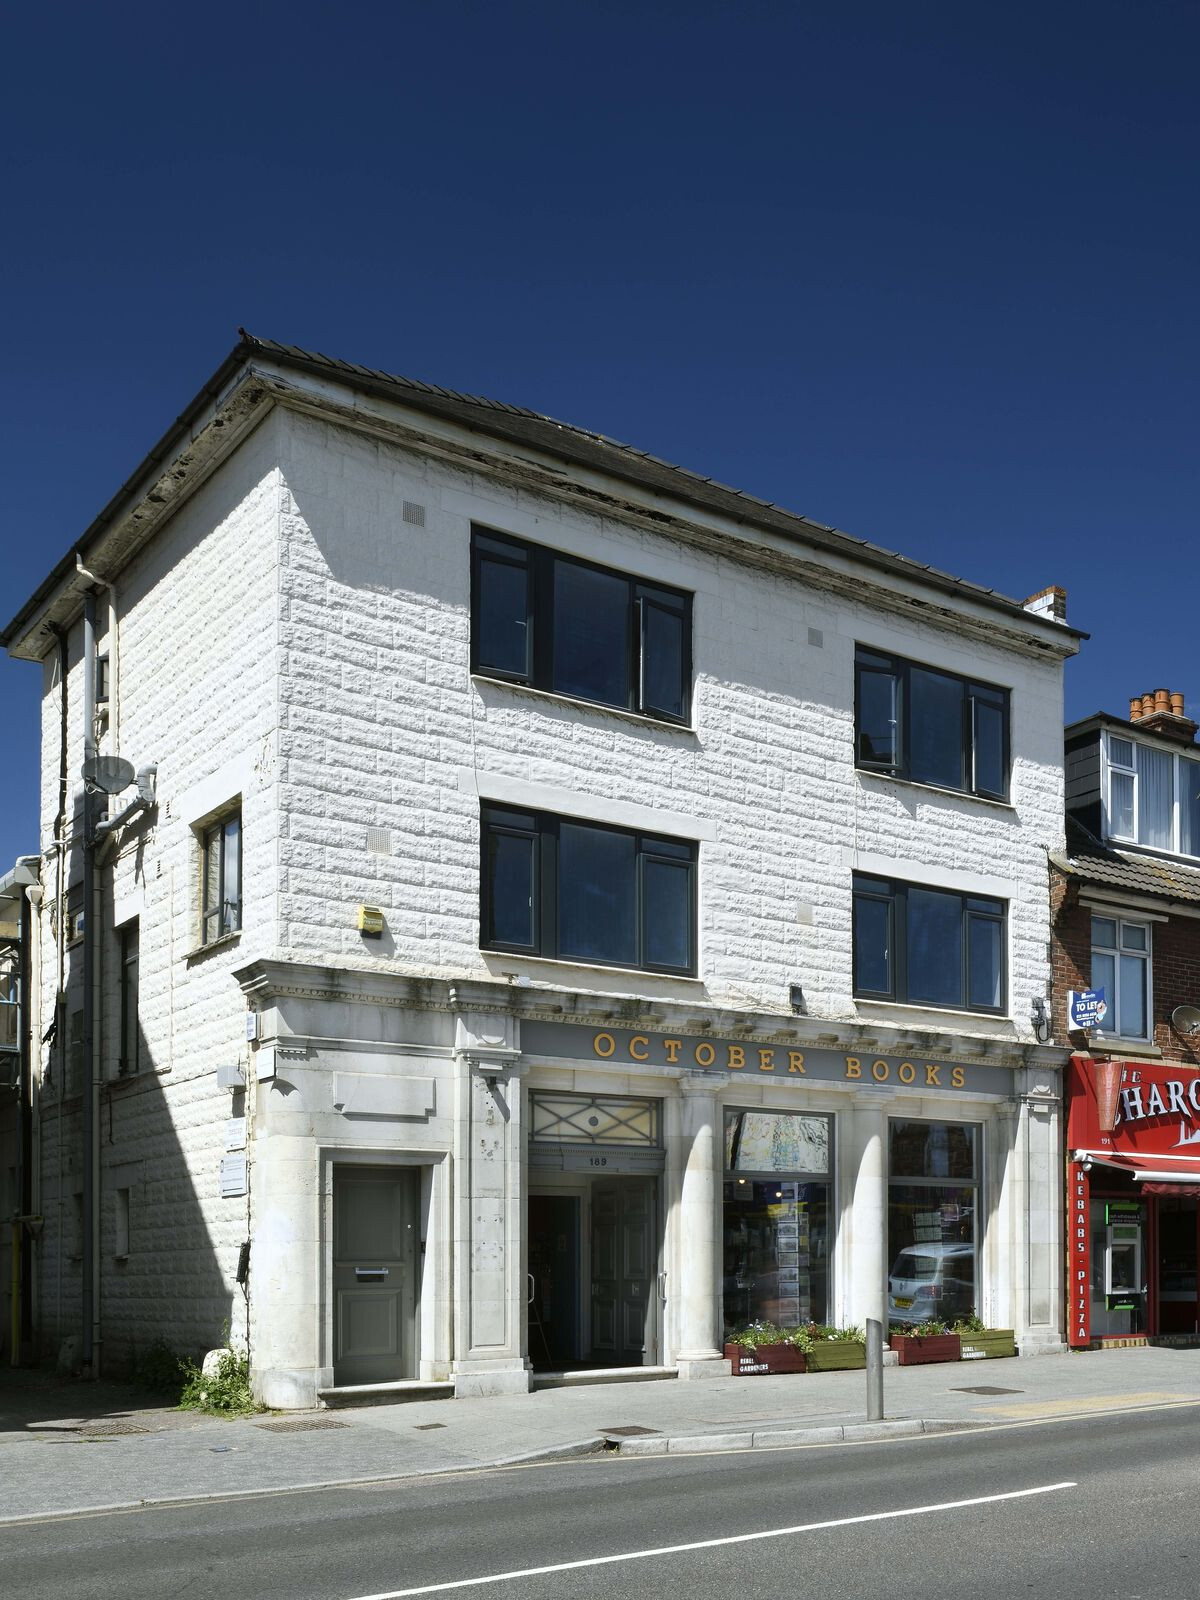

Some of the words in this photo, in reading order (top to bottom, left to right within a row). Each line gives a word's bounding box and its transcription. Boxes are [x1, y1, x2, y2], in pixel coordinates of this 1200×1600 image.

[1076, 1003, 1086, 1012] TO
[1087, 1001, 1098, 1010] LET
[593, 1032, 806, 1074] OCTOBER
[846, 1056, 966, 1088] BOOKS
[1077, 1270, 1086, 1338] PIZZA
